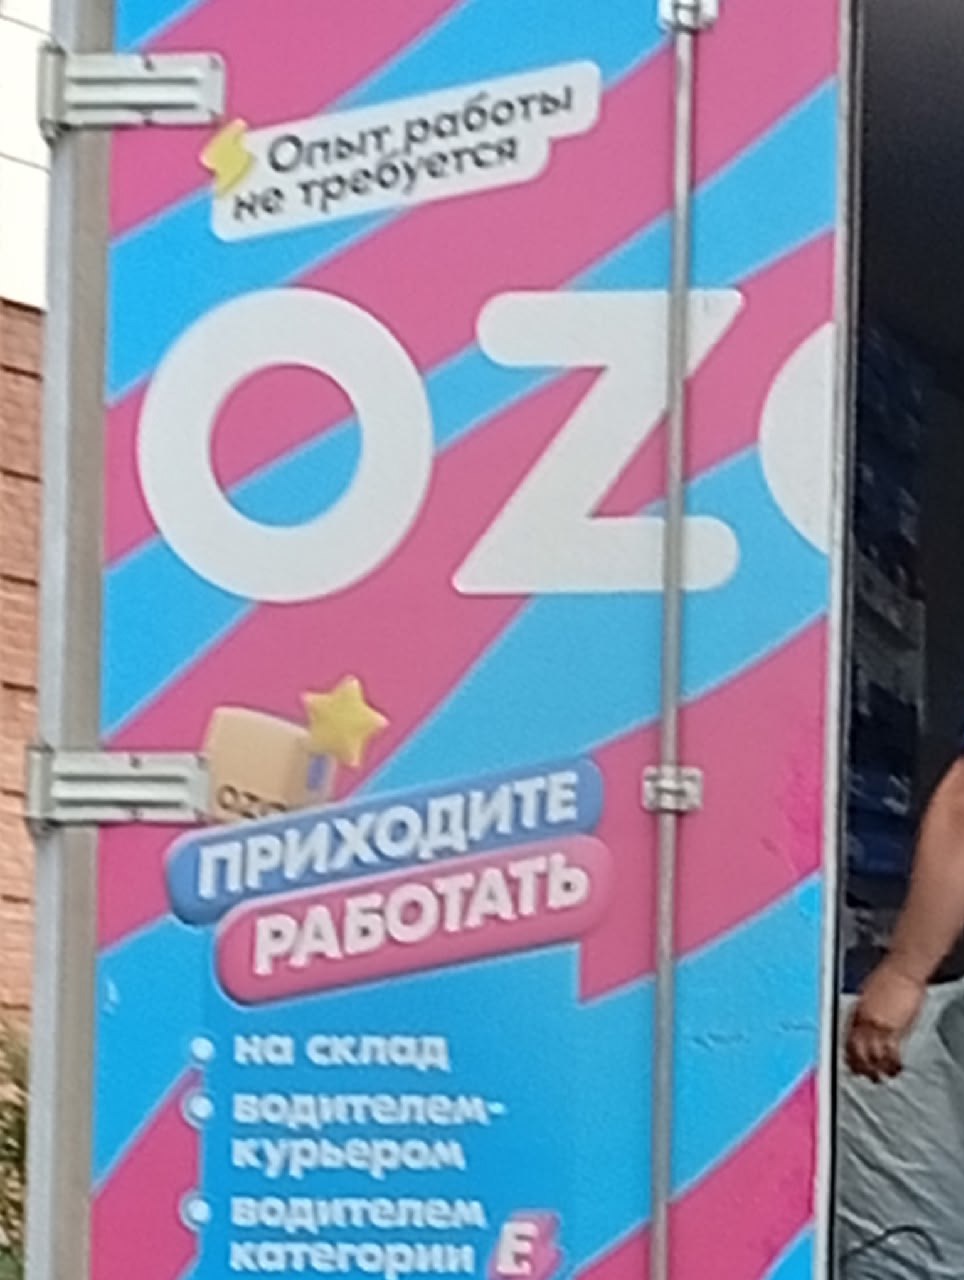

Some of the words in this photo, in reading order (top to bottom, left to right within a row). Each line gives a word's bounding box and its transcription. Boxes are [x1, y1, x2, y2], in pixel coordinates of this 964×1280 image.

[267, 125, 391, 174] Опыт
[403, 86, 575, 154] работы
[233, 185, 285, 221] не
[299, 138, 520, 212] требуется
[198, 771, 580, 898] ПРИХОДИТЕ
[253, 853, 590, 975] РАБОТАТЬ
[233, 1035, 295, 1065] на
[306, 1035, 450, 1072] склад
[232, 1093, 506, 1130] водителем-
[231, 1138, 467, 1179] курьером
[230, 1196, 488, 1234] водителем
